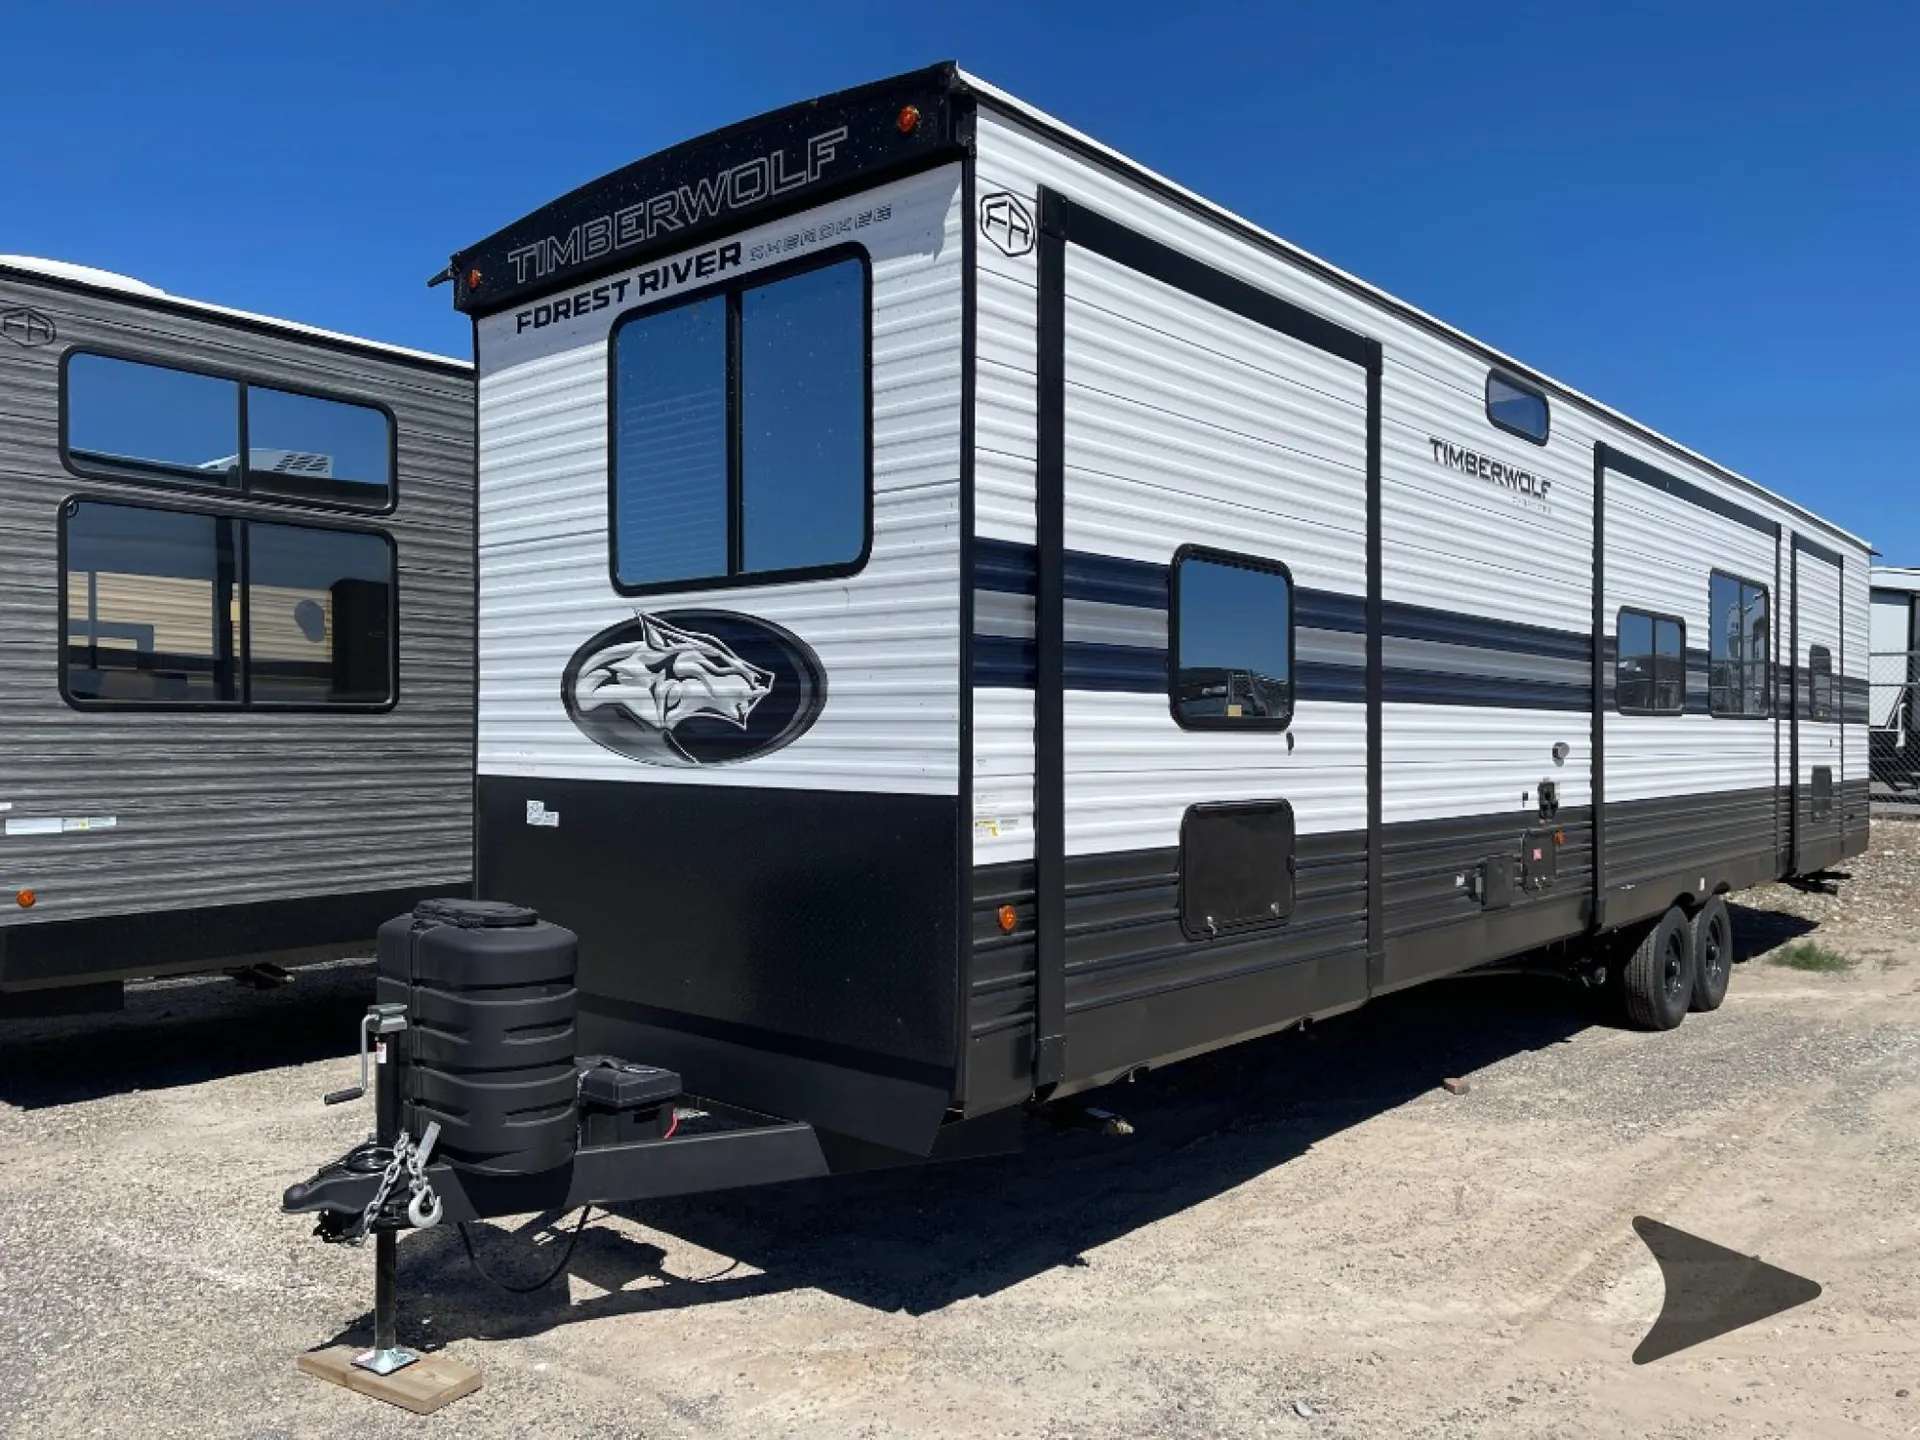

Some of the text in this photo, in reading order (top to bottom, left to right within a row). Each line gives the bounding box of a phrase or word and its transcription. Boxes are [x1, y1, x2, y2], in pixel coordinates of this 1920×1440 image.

[508, 125, 848, 284] TIMBERWOLF
[515, 277, 631, 335] FOREST
[637, 241, 742, 297] RIVER
[1429, 437, 1552, 501] TIMBERWOLF
